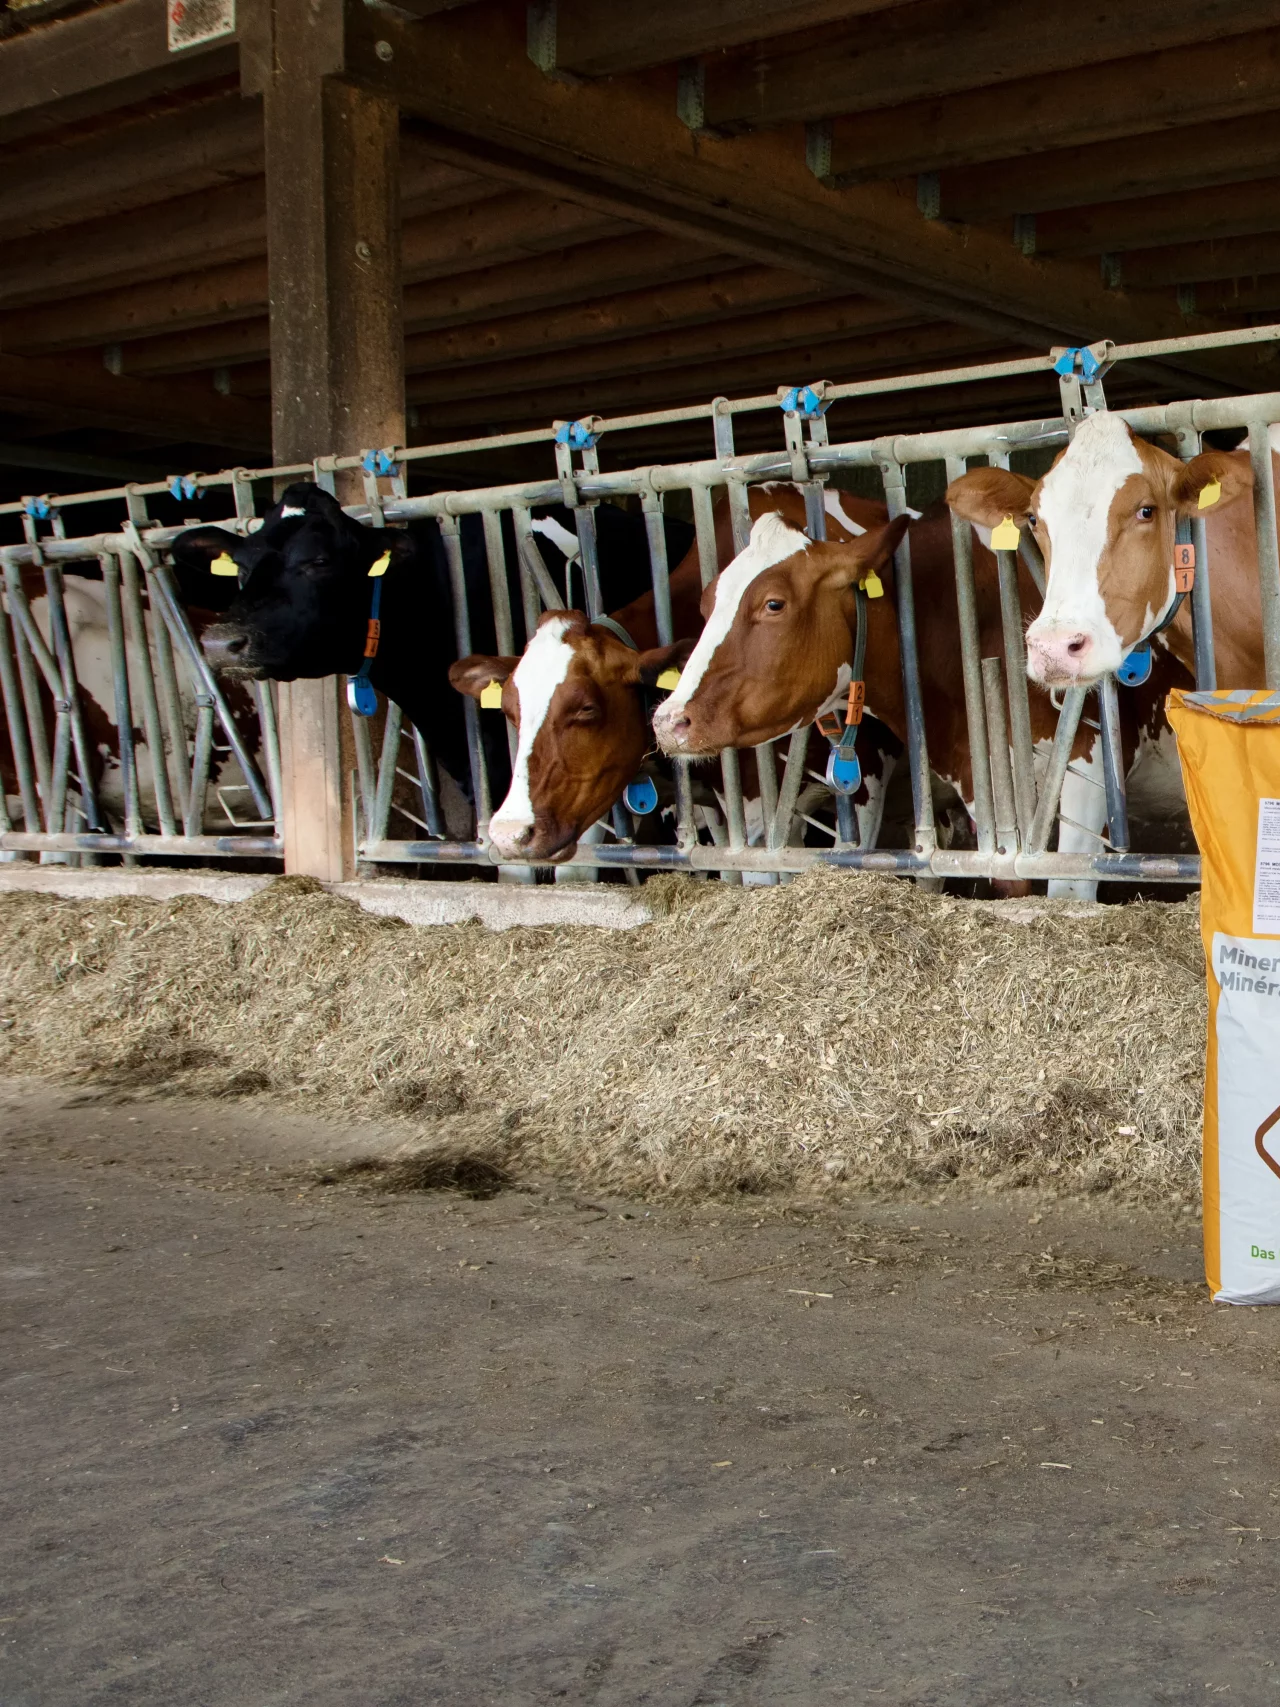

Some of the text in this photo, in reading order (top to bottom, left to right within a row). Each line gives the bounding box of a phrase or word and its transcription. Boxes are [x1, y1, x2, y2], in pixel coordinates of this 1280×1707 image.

[1182, 548, 1190, 565] 8
[1182, 572, 1188, 589] 1
[857, 684, 863, 700] 2
[1251, 1245, 1275, 1260] Das
